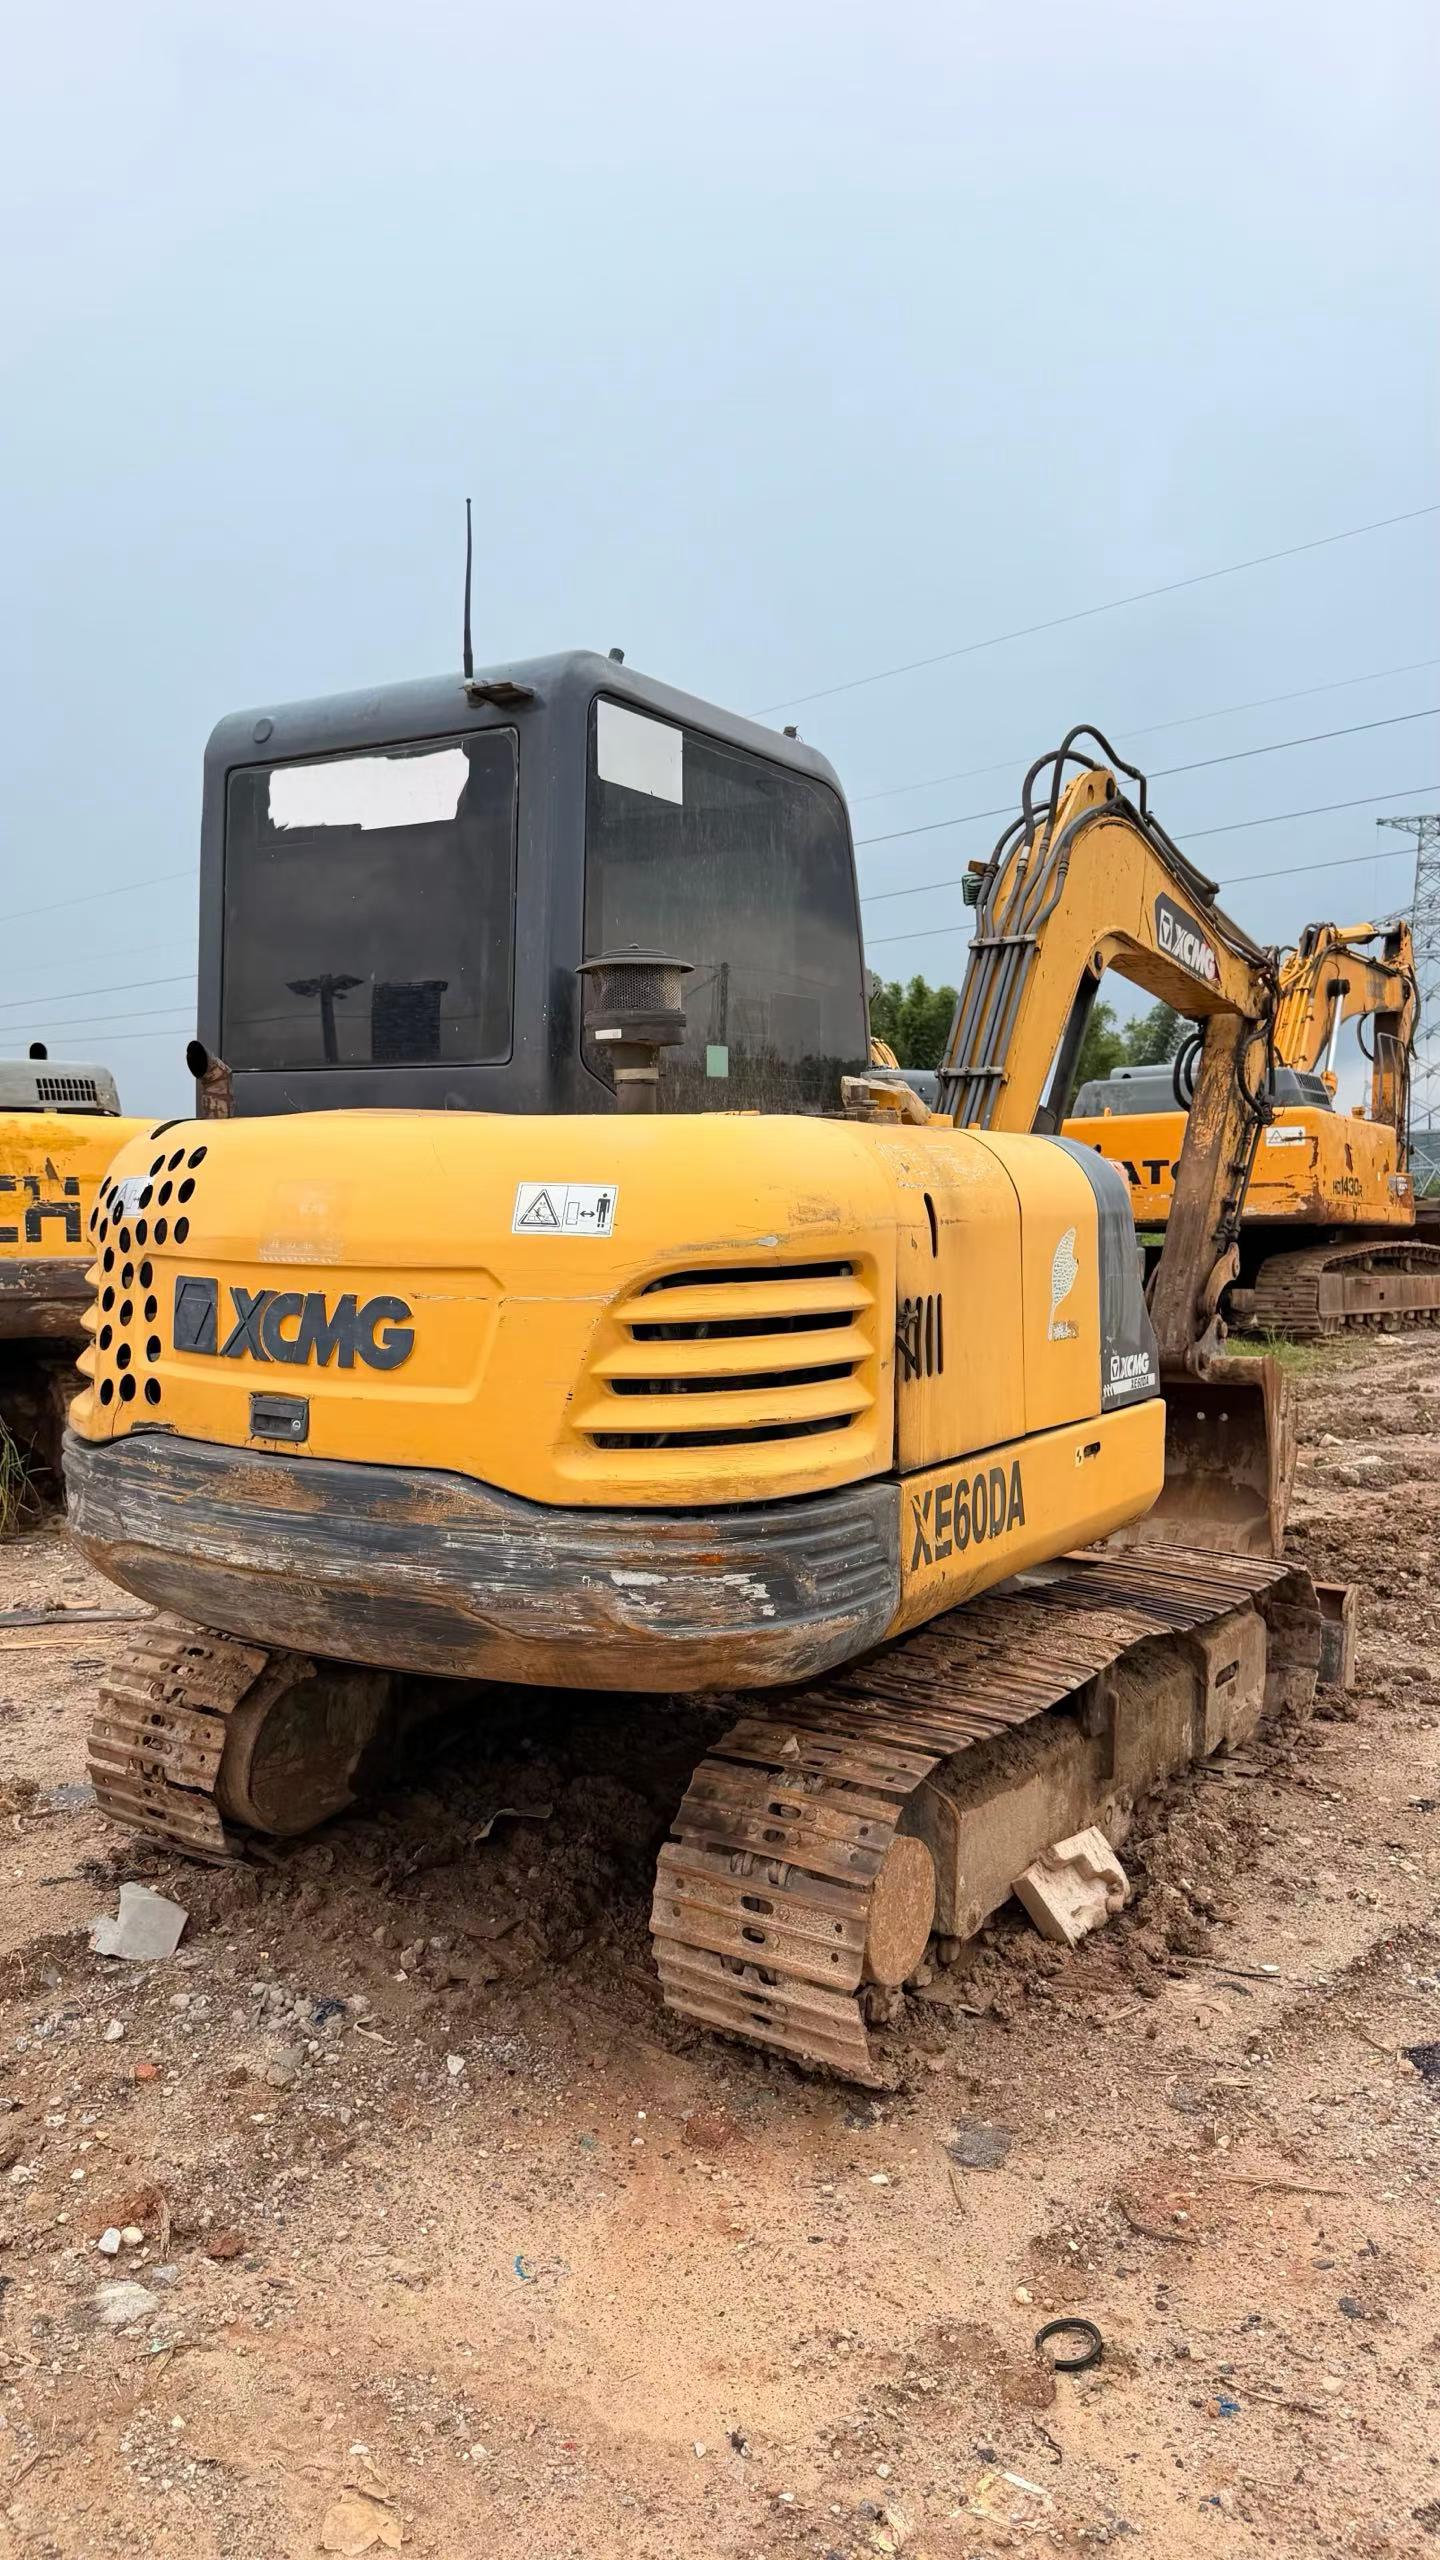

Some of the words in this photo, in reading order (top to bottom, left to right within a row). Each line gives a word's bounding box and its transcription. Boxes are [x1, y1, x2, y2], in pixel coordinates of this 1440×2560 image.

[1171, 923, 1216, 980] XCMG
[219, 1286, 416, 1371] XCMG
[1120, 1352, 1150, 1379] XCMG
[910, 1460, 1026, 1572] XE60DA
